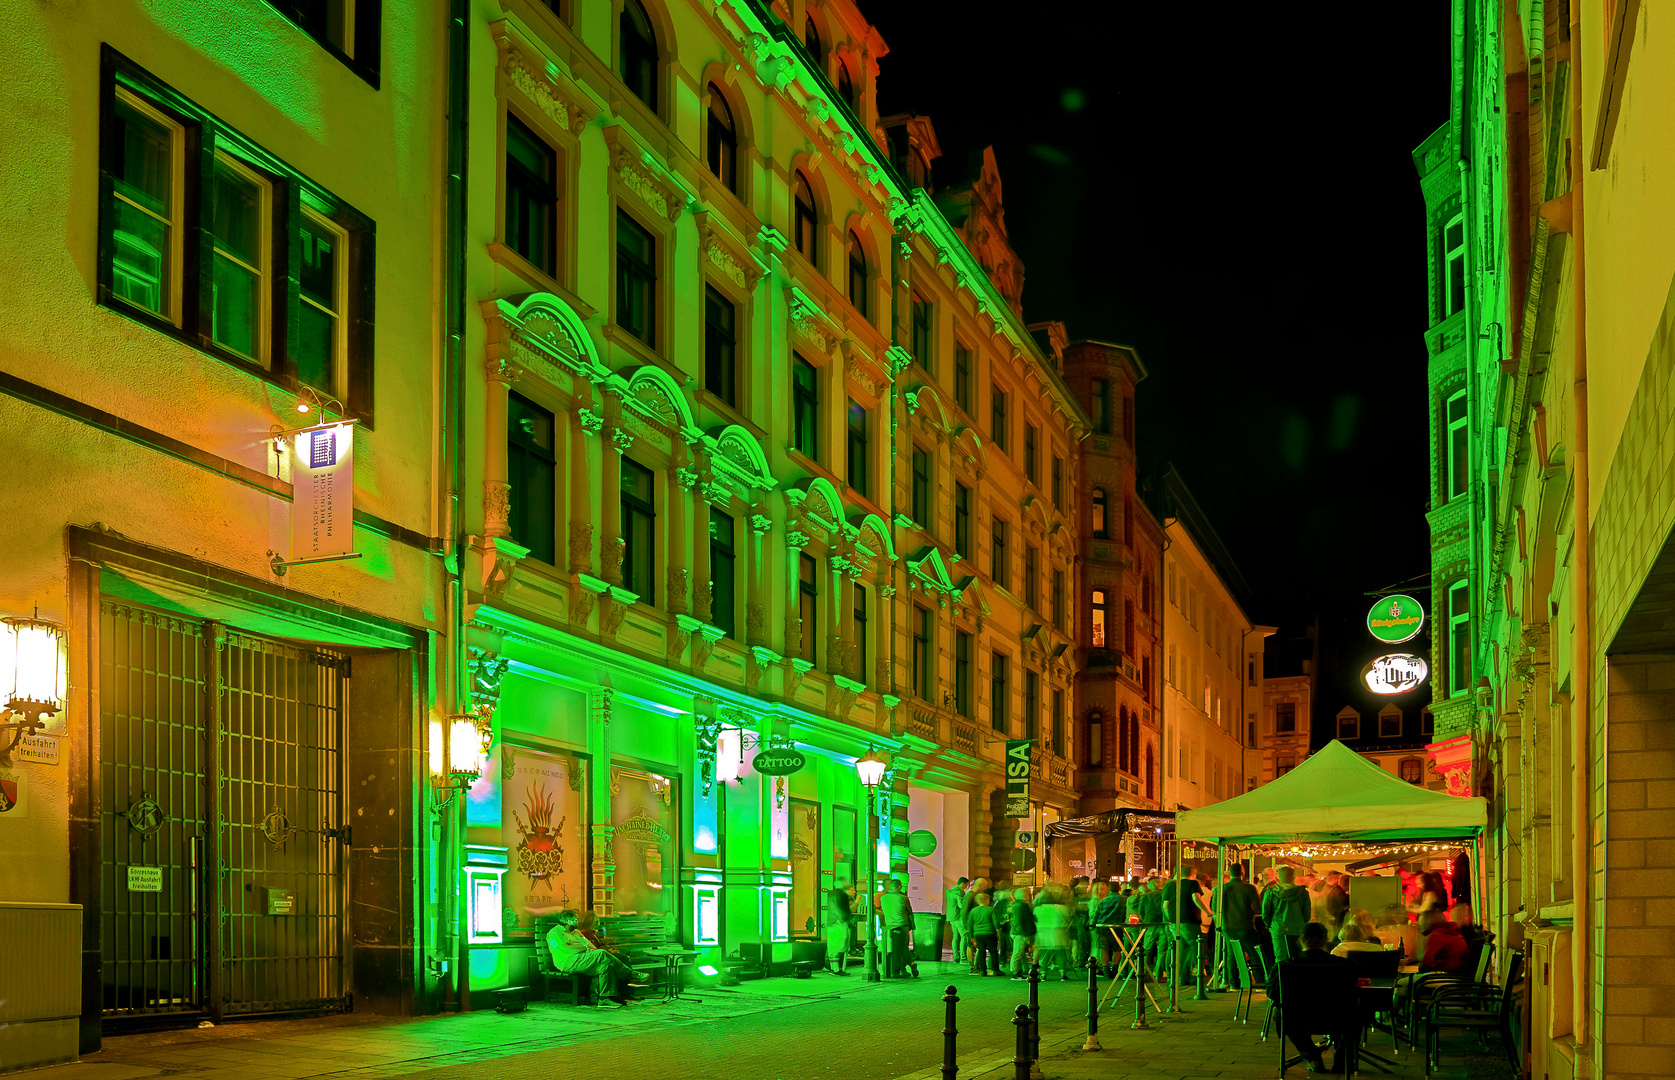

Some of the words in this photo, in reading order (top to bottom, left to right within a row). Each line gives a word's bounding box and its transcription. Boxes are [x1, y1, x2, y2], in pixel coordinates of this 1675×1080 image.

[23, 737, 56, 749] Ausfahrt
[20, 748, 58, 760] freihalten!
[756, 758, 802, 768] TATTOO
[1008, 743, 1030, 798] LISA
